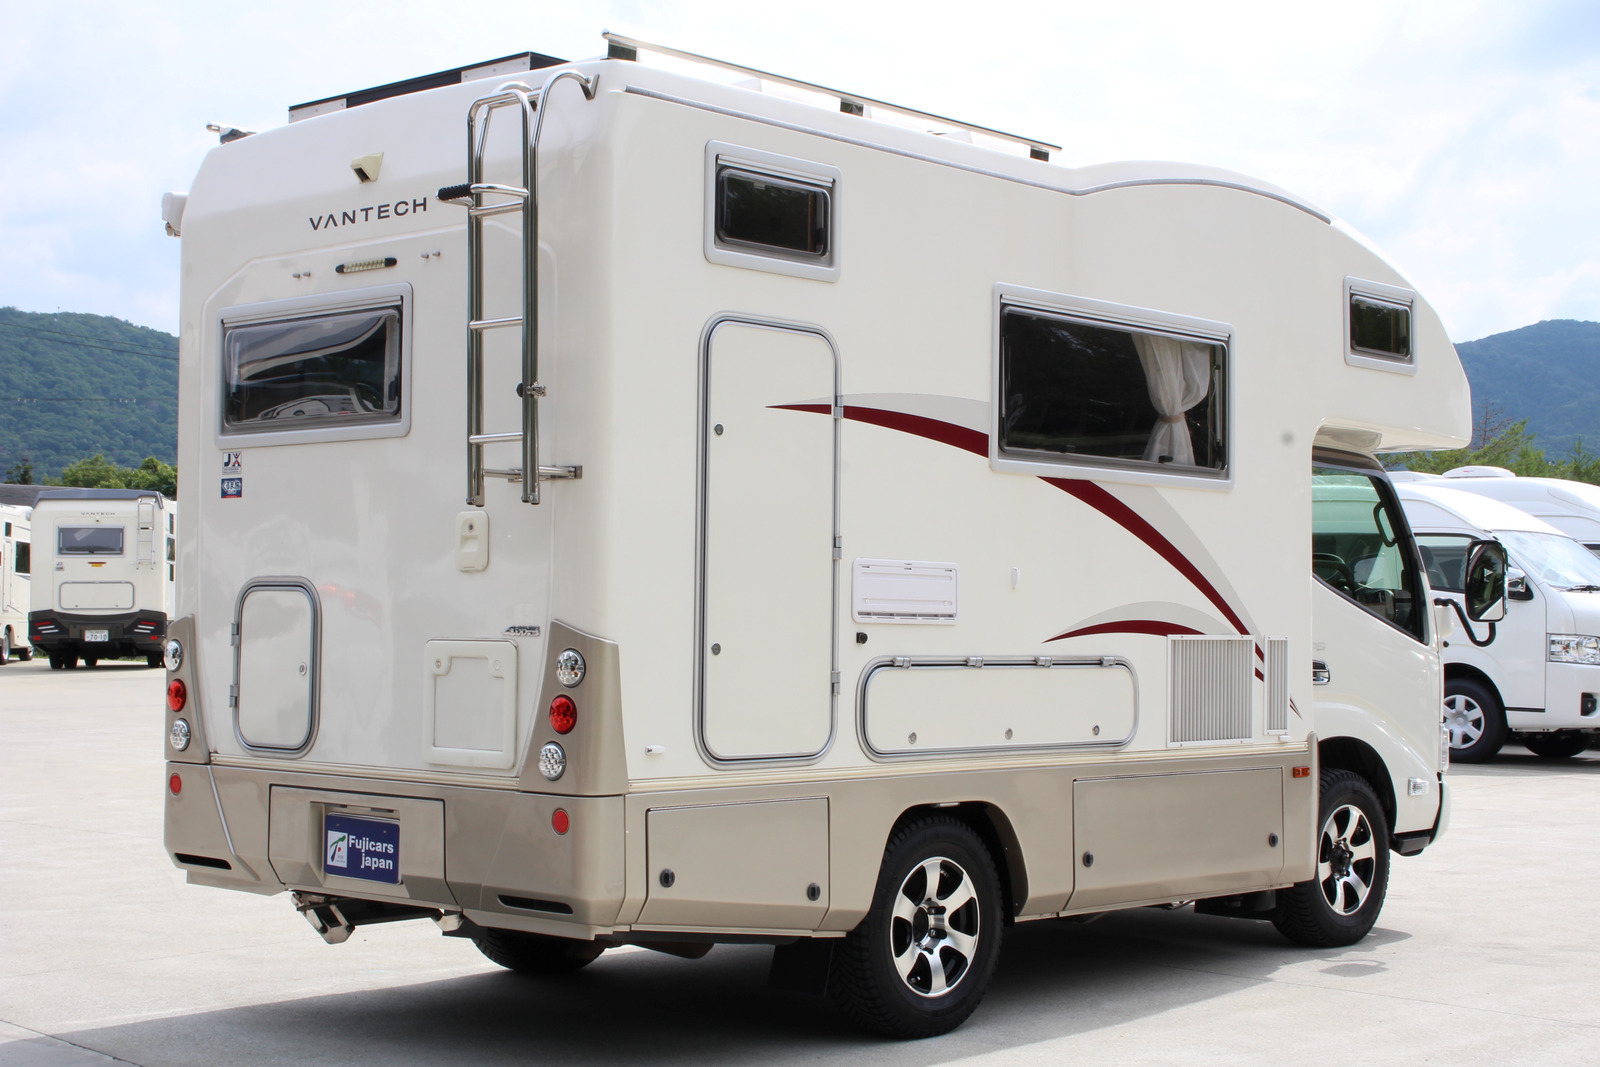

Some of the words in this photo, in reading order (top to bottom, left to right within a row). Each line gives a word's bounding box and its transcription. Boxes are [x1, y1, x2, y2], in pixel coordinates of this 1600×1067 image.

[309, 197, 427, 231] VANTECH
[348, 835, 394, 854] Fujicars
[360, 853, 393, 871] japan
